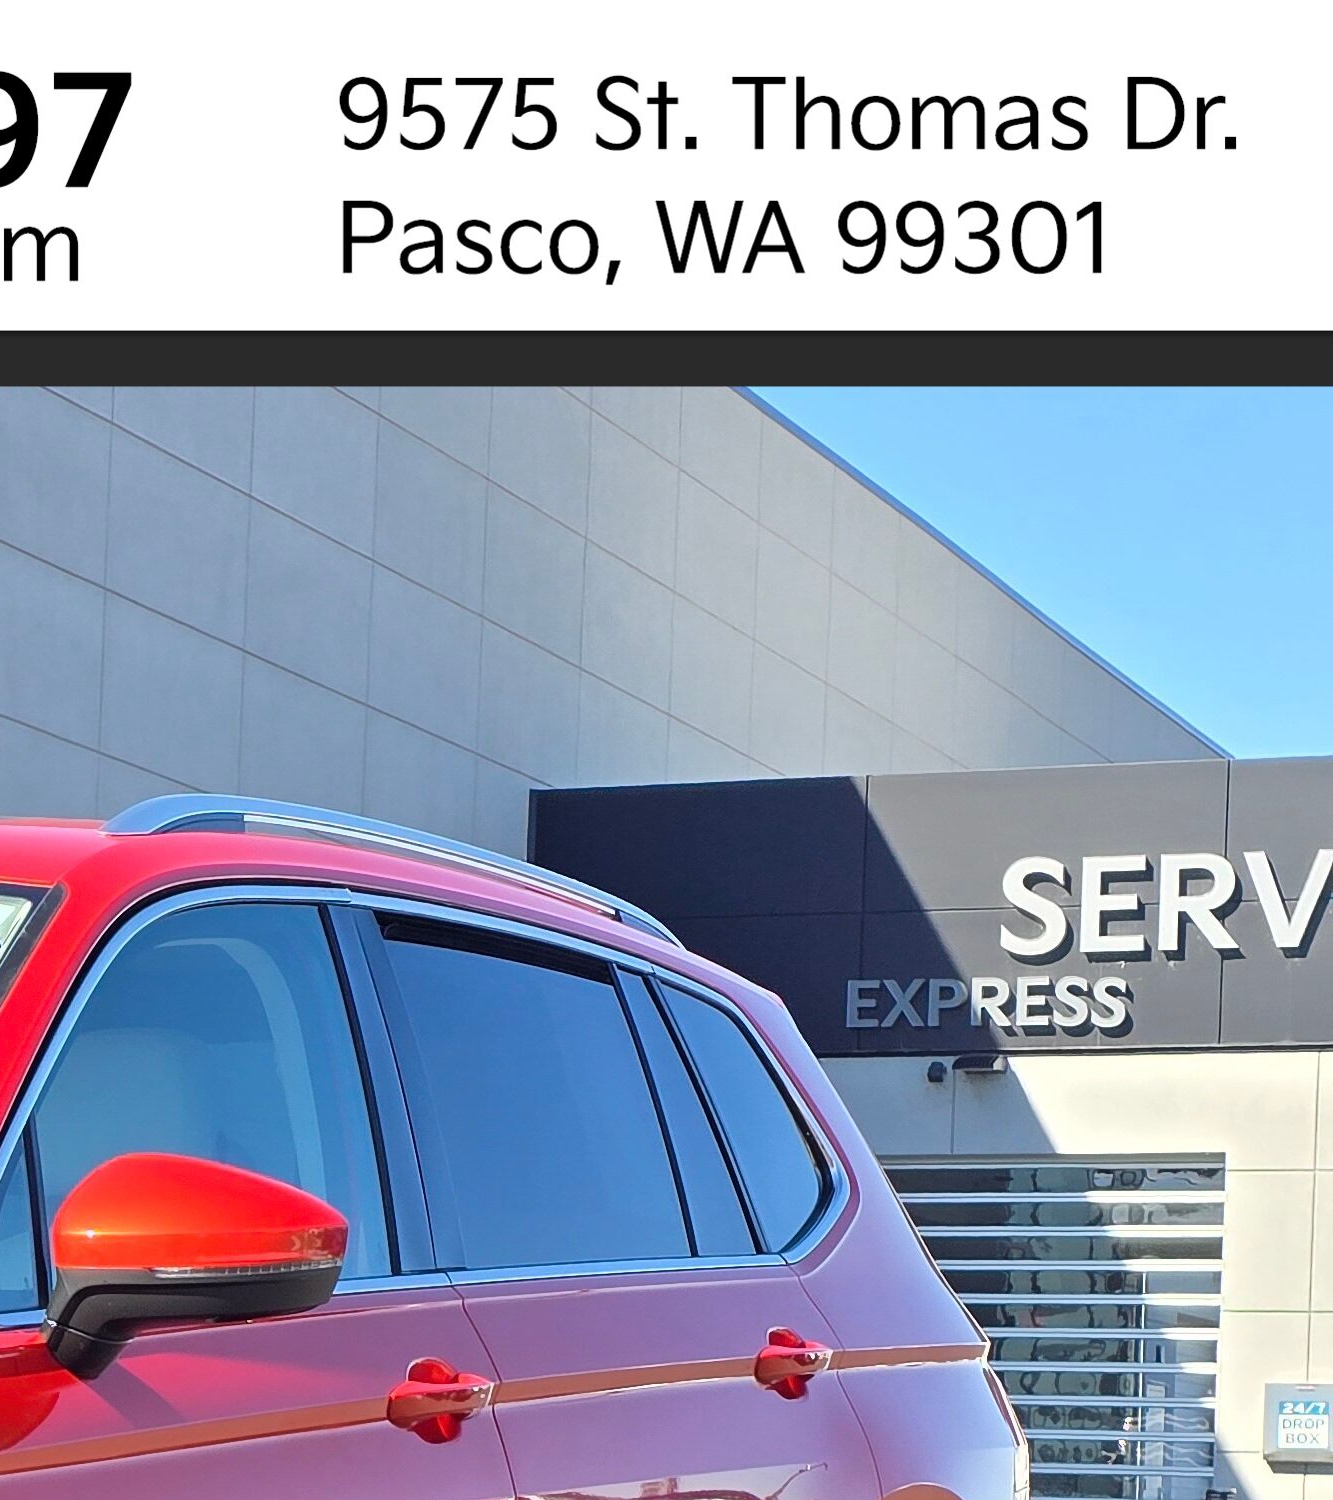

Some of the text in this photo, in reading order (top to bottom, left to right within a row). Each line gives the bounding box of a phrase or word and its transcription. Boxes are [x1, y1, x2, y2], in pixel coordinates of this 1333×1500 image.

[1000, 848, 1333, 957] SERV
[846, 976, 1128, 1029] EXPRESS
[1282, 1402, 1326, 1414] 24/7
[1282, 1418, 1325, 1429] DROP
[1285, 1433, 1320, 1444] BOX
